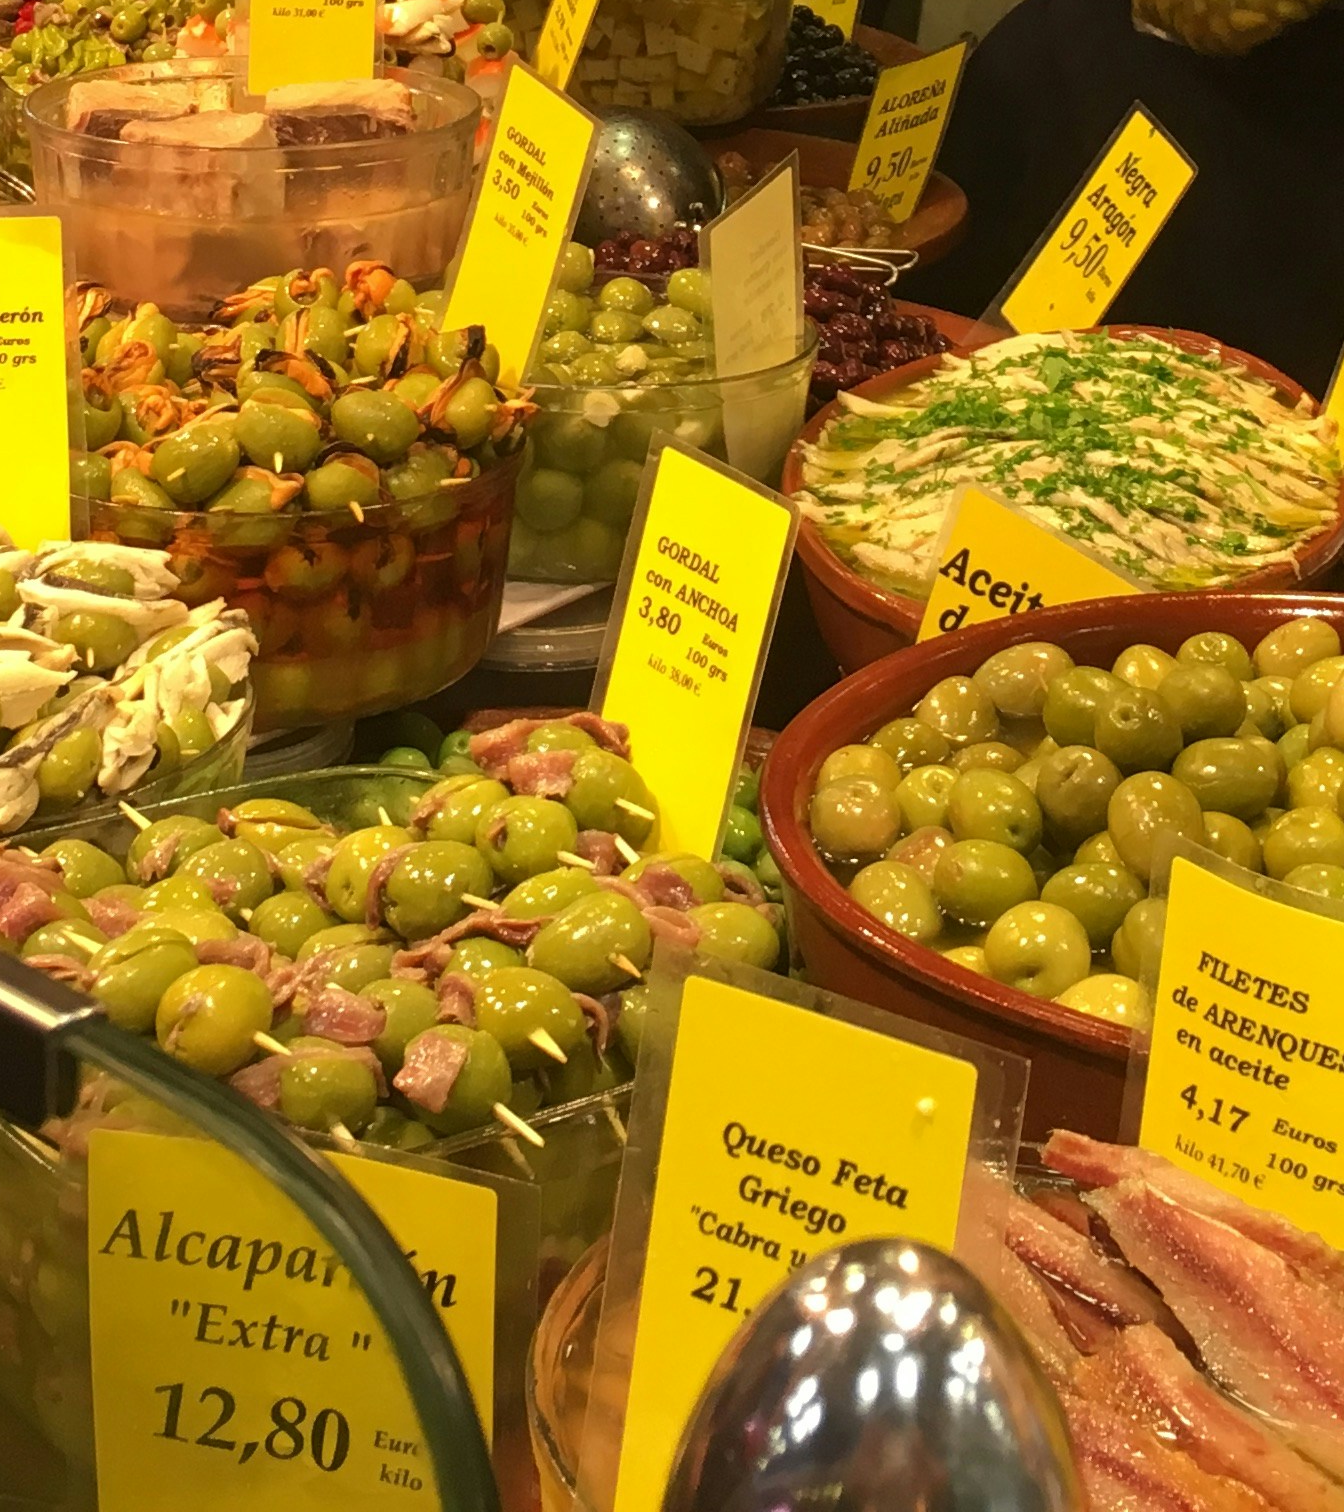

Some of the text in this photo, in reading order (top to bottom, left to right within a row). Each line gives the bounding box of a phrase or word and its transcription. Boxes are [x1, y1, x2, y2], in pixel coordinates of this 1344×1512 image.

[272, 7, 292, 17] kilo
[346, 0, 365, 9] grs
[874, 105, 940, 139] Aliñada
[877, 79, 947, 116] ALOREÑA
[506, 125, 546, 166] GORDAL
[863, 146, 913, 190] 9,50
[492, 168, 520, 200] 3,50
[498, 149, 554, 201] con Mejillón
[1115, 151, 1158, 209] Negra
[521, 209, 536, 226] 100
[1086, 183, 1137, 248] Aragón
[1060, 218, 1109, 278] 9,50
[12, 354, 37, 368] grs
[657, 535, 721, 584] GORDAL
[939, 547, 1045, 615] Aceit
[638, 595, 730, 658] 3,80 Euros
[646, 569, 739, 634] con ANCHOA
[647, 653, 668, 675] kilo
[668, 666, 694, 692] 38,00
[685, 646, 728, 683] 100 grs
[1172, 985, 1199, 1014] de
[1197, 951, 1311, 1015] FILETES
[1176, 1027, 1292, 1091] en aceite
[1180, 1083, 1339, 1155] 4,17 Euros
[722, 1121, 910, 1211] Queso Feta
[1174, 1134, 1205, 1164] kilo
[1207, 1147, 1252, 1185] 41,70
[1265, 1151, 1309, 1181] 100
[738, 1174, 848, 1235] Griego
[689, 1205, 781, 1257] "Cabra
[153, 1382, 351, 1474] 12,80
[379, 1464, 424, 1492] kilo
